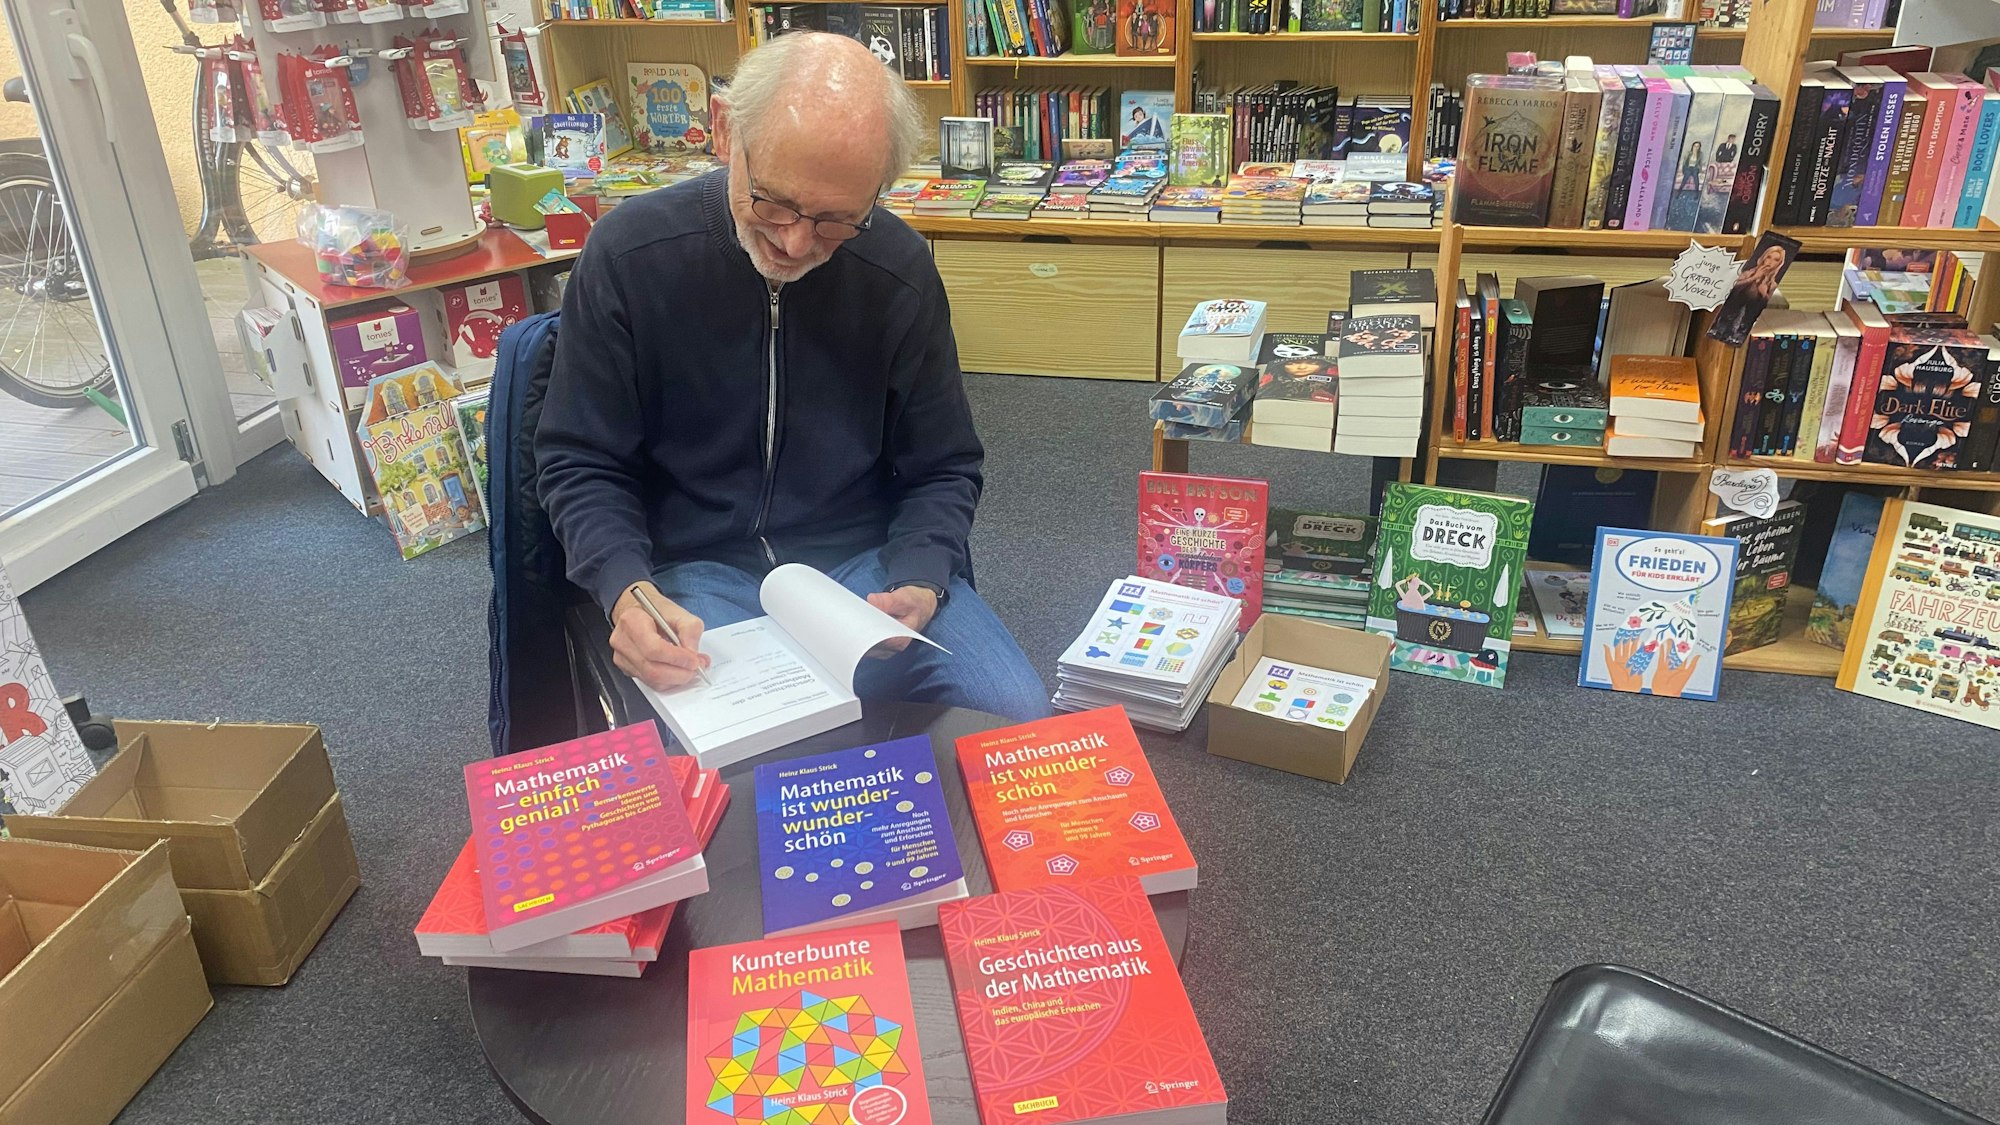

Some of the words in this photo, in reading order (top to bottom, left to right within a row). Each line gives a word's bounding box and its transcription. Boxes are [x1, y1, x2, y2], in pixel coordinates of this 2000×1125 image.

[644, 68, 666, 76] ROALD
[652, 87, 681, 103] 100
[1478, 97, 1519, 106] REBECCA
[1521, 99, 1558, 108] YARROS
[656, 104, 678, 112] erste
[1653, 97, 1662, 119] KELLY
[1576, 107, 1587, 131] WING
[1876, 126, 1891, 162] STOLEN
[1884, 92, 1898, 125] KISSES
[1910, 114, 1921, 134] HUGO
[1931, 100, 1946, 140] DECEPTION
[201, 108, 214, 169] COLUMBUS
[1485, 133, 1537, 154] IRON
[1748, 112, 1769, 157] SORRY
[1972, 147, 1986, 172] BOOK
[1979, 111, 1995, 145] LOVERS
[1895, 140, 1907, 163] SIEBEN
[1905, 134, 1916, 158] EVELYN
[1927, 140, 1937, 160] LOVE
[1478, 156, 1538, 174] FLAME
[1791, 153, 1803, 183] NIEHOFF
[1814, 165, 1831, 203] TROTZE
[1824, 127, 1838, 159] NACHT
[1892, 164, 1901, 175] DIE
[1902, 158, 1911, 172] DER
[1787, 184, 1796, 205] MARIE
[1966, 178, 1976, 198] EMILY
[1973, 178, 1984, 199] HENRY
[1698, 255, 1721, 272] junge
[1681, 266, 1724, 289] GRAPHIC
[473, 296, 496, 305] tonies
[366, 330, 392, 341] tonies
[1473, 336, 1481, 350] okay
[1472, 358, 1481, 388] Everything
[1916, 365, 1953, 373] HAUSBURG
[1172, 378, 1237, 392] SIRENS
[1881, 397, 1924, 415] Dark
[1928, 399, 1967, 421] Elite
[1146, 480, 1179, 495] BILL
[1186, 483, 1257, 502] BRYSON
[1303, 524, 1357, 534] DRECK
[1446, 521, 1464, 529] Buch
[1732, 522, 1754, 532] PETER
[1757, 511, 1801, 526] WOHLLEBEN
[1171, 536, 1226, 549] GESCHICHTE
[1175, 528, 1190, 536] EINE
[1192, 529, 1216, 538] KURZE
[1423, 526, 1486, 549] DRECK
[1754, 525, 1793, 546] geheime
[1746, 542, 1775, 556] Leben
[1179, 559, 1217, 572] KÖRPERS
[1629, 555, 1706, 574] FRIEDEN
[1752, 552, 1785, 568] Bäume
[1632, 570, 1646, 578] FÜR
[1666, 573, 1700, 583] ERKLÄRT
[980, 740, 999, 749] Heinz
[1000, 736, 1017, 744] Klaus
[1018, 732, 1036, 741] Strick
[985, 733, 1109, 768] Mathematik
[491, 765, 512, 775] Heinz
[513, 761, 533, 770] Klaus
[534, 755, 555, 765] Strick
[779, 768, 798, 778] Heinz
[799, 766, 817, 775] Klaus
[818, 763, 837, 772] Strick
[990, 770, 1014, 785] ist
[1020, 755, 1107, 781] wunder-
[494, 752, 628, 799] Mathematik
[781, 767, 904, 801] Mathematik
[519, 776, 600, 809] einfach
[594, 784, 656, 807] Bemerkenswerte
[621, 795, 642, 805] Ideen
[643, 789, 658, 798] und
[781, 802, 807, 818] ist
[811, 787, 900, 812] wunder-
[996, 781, 1057, 804] schön
[600, 801, 644, 819] Geschichten
[1002, 805, 1019, 816] Noch
[1020, 804, 1037, 814] mehr
[1038, 799, 1077, 811] Anregungen
[1093, 792, 1128, 803] Anschauen
[500, 797, 581, 835] genial!
[581, 815, 624, 831] Pythagoras
[637, 801, 662, 813] Cantor
[783, 811, 873, 835] wunder-
[872, 824, 889, 832] mehr
[890, 817, 930, 829] Anregungen
[1004, 815, 1018, 823] und
[1018, 810, 1052, 821] Erforschen
[1071, 817, 1104, 827] Menschen
[897, 824, 932, 835] Anschauen
[899, 830, 933, 841] Erforschen
[1063, 827, 1093, 835] zwischen
[1065, 834, 1079, 842] und
[1089, 830, 1111, 839] Jahren
[784, 830, 846, 853] schön
[902, 839, 935, 850] Menschen
[907, 845, 937, 856] zwischen
[645, 847, 680, 867] Springer
[892, 858, 905, 866] und
[916, 851, 938, 861] Jahren
[1140, 853, 1174, 863] Springer
[913, 873, 946, 887] Springer
[974, 936, 996, 948] Heinz
[997, 932, 1018, 944] Klaus
[1019, 928, 1041, 940] Strick
[732, 939, 870, 974] Kunterbunte
[978, 942, 1104, 977] Geschichten
[1107, 939, 1142, 954] aus
[732, 958, 874, 996] Mathematik
[985, 975, 1018, 1000] der
[1022, 957, 1151, 993] Mathematik
[992, 1004, 1021, 1017] Indien,
[1022, 1000, 1046, 1011] China
[1047, 997, 1063, 1007] und
[994, 1015, 1010, 1026] das
[1011, 1009, 1060, 1024] europäische
[1060, 1002, 1101, 1015] Erwachen
[1159, 1079, 1199, 1091] Springer
[771, 1094, 795, 1107] Heinz
[797, 1092, 822, 1103] Klaus
[823, 1088, 848, 1100] Strick
[1017, 1099, 1055, 1111] SACHBUCH
